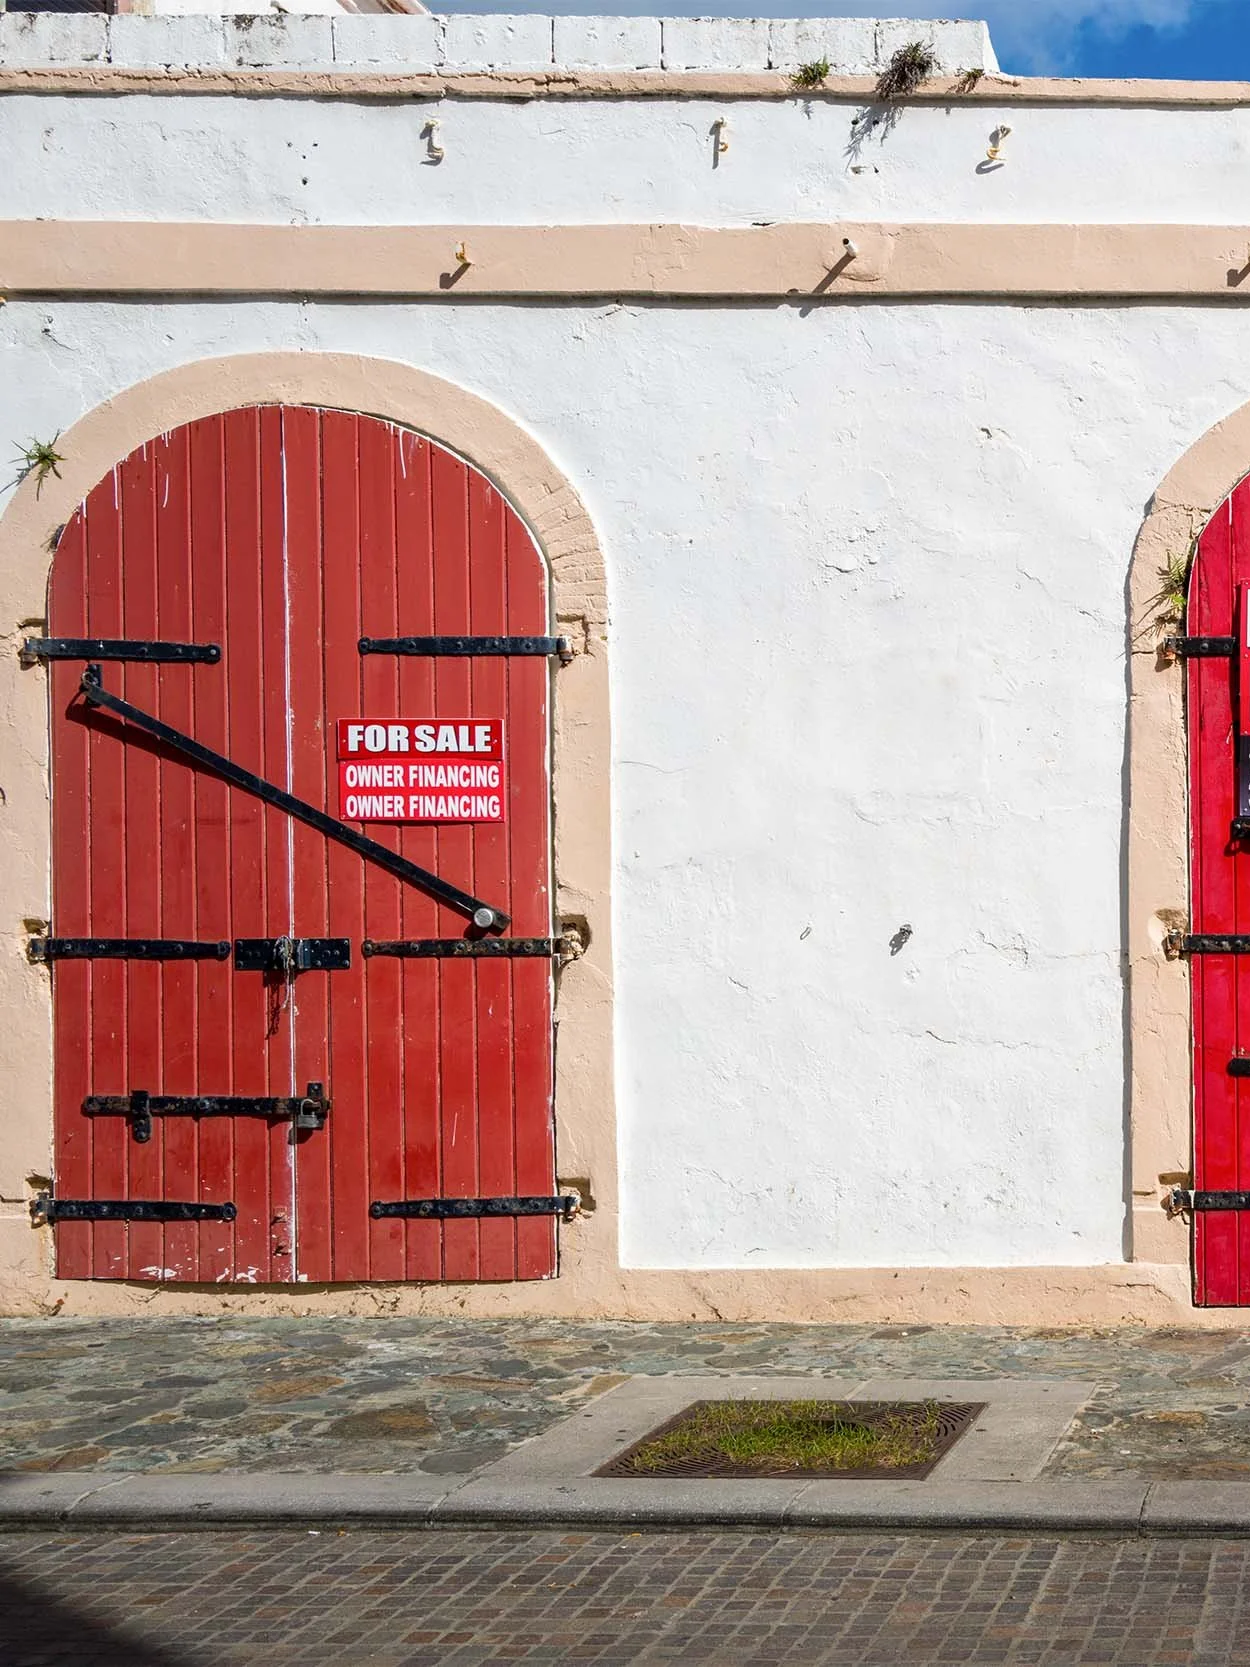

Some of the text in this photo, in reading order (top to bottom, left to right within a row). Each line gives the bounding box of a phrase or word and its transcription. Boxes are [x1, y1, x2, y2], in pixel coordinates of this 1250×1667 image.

[347, 725, 492, 752] FOR SALE
[345, 765, 499, 788] OWNER FINANCING
[346, 796, 500, 818] OWNER FINANCING
